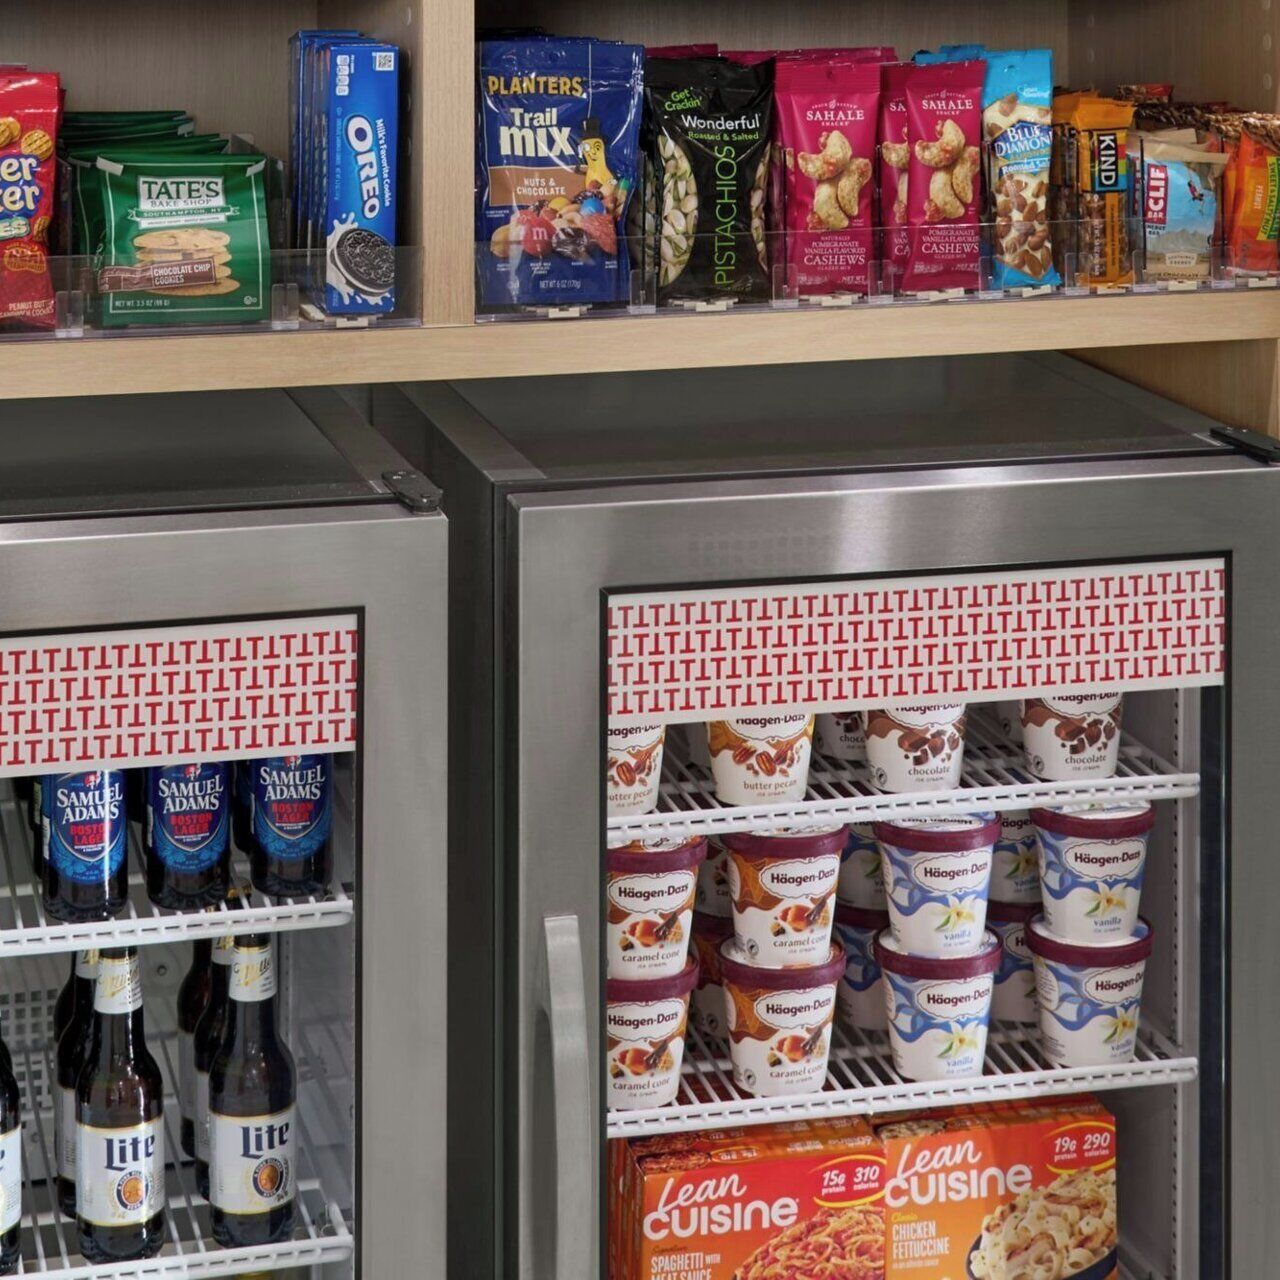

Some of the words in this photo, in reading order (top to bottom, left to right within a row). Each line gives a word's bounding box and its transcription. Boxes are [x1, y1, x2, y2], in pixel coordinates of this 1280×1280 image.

[488, 76, 583, 96] PLANTERS
[671, 90, 691, 102] Get
[921, 99, 973, 110] SAHALE
[510, 107, 557, 126] Trail
[682, 114, 760, 130] Wonderful
[806, 110, 864, 120] SAHALE
[500, 125, 574, 157] mix
[688, 132, 720, 140] Roasted
[731, 132, 759, 141] Salted
[1006, 124, 1043, 141] BLUE
[347, 116, 380, 219] OREO
[380, 144, 389, 178] Favorite
[1098, 134, 1116, 186] KIND
[142, 181, 219, 200] TATE'S
[517, 186, 566, 195] CHOCOLATE
[524, 178, 547, 187] NUTS
[1146, 164, 1168, 211] CLIF
[714, 146, 737, 285] PISTACHIOS
[922, 242, 979, 254] CASHEWS
[804, 255, 865, 265] CASHEWS
[154, 265, 192, 276] CHOCOLATE
[194, 264, 210, 272] CHIP
[155, 275, 184, 285] COOKIES
[1065, 754, 1107, 765] chocolate
[260, 764, 326, 786] SAMUEL
[908, 764, 951, 776] chocolate
[57, 782, 123, 807] SAMUEL
[158, 778, 224, 800] SAMUEL
[264, 782, 321, 801] ADAMS
[743, 780, 768, 791] butter
[62, 802, 119, 824] ADAMS
[163, 794, 220, 814] ADAMS
[174, 823, 210, 835] LAGER
[1093, 917, 1122, 927] vanilla
[773, 938, 809, 948] caramel
[622, 952, 660, 962] caramel
[769, 1068, 804, 1078] caramel
[613, 1080, 650, 1090] caramel
[241, 1122, 290, 1160] Lite
[1082, 1133, 1110, 1151] 290
[104, 1133, 155, 1171] Lite
[894, 1139, 983, 1186] Lean
[853, 1166, 880, 1184] 310
[658, 1173, 747, 1215] Lean
[893, 1221, 937, 1241] CHICKEN
[893, 1238, 950, 1256] FETTUCCINE
[651, 1253, 704, 1271] SPAGHETTI
